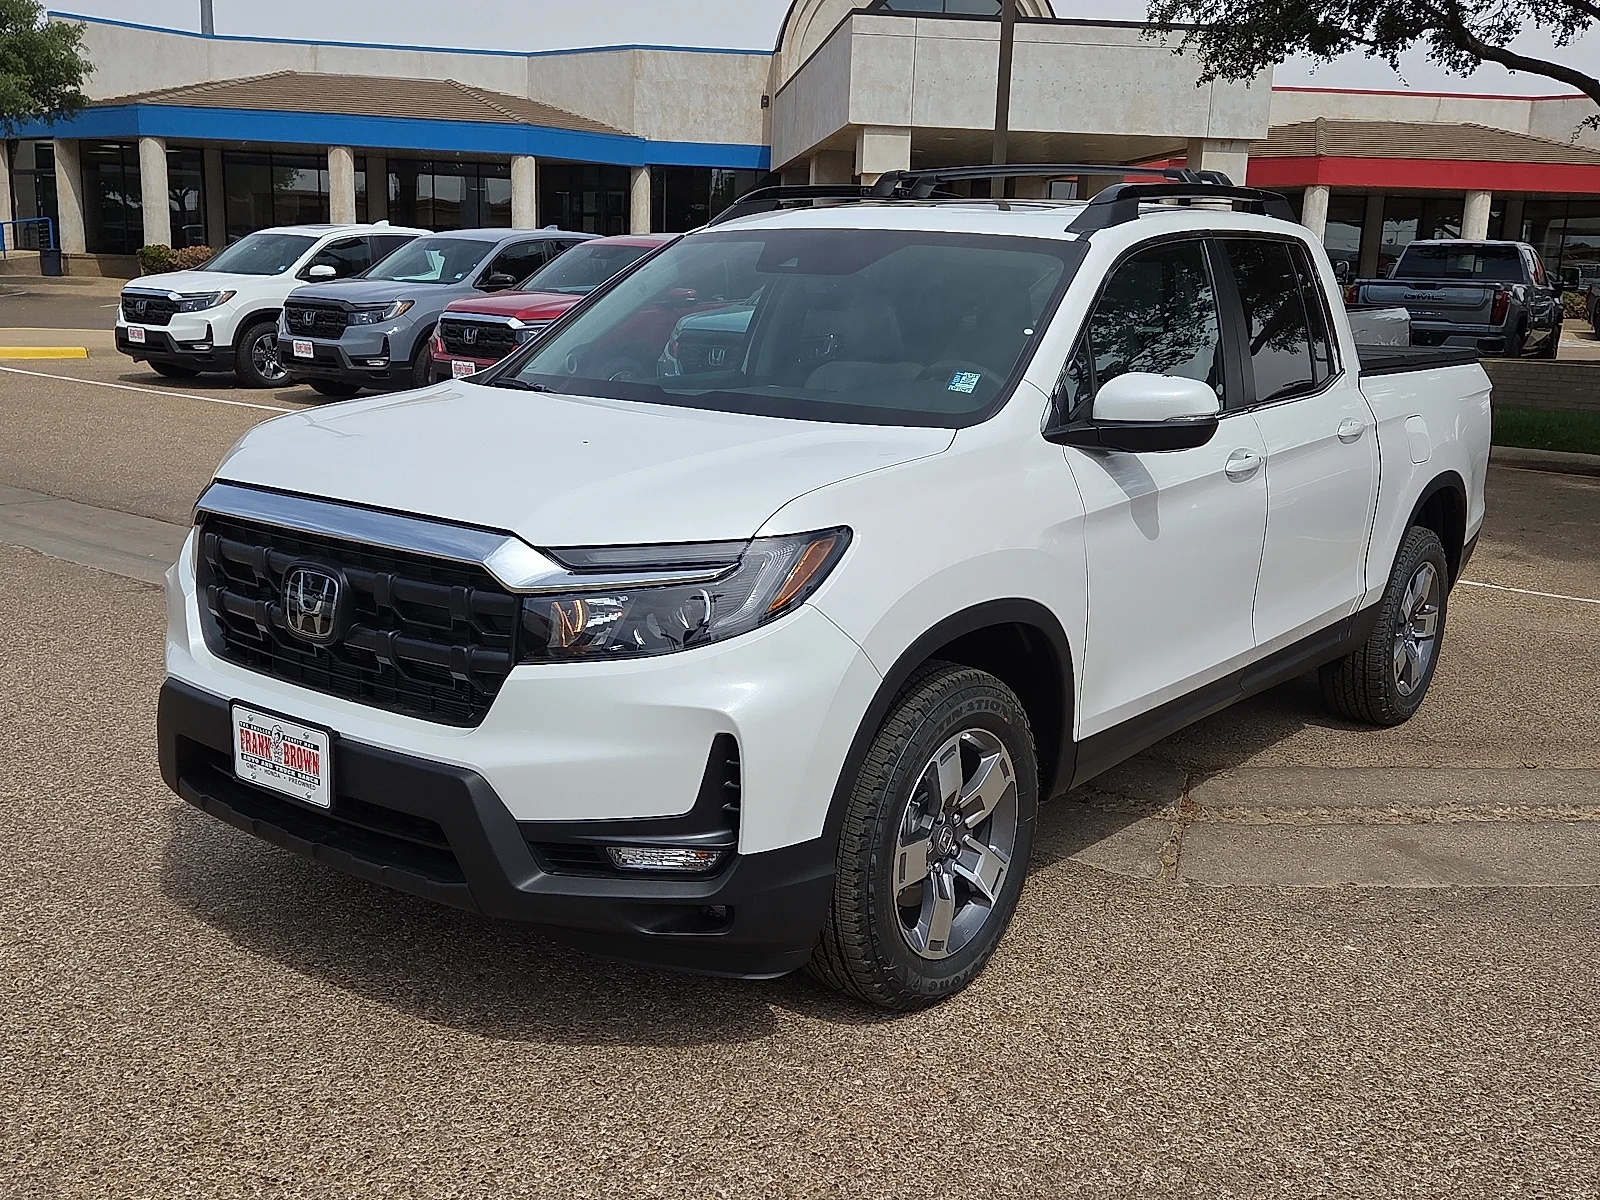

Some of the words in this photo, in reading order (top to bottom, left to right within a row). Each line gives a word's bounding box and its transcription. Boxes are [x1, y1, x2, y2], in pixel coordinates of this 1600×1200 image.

[1404, 292, 1446, 300] GMC
[239, 727, 271, 760] FRANK
[283, 742, 319, 776] BROWN
[242, 753, 259, 764] AUTO
[260, 759, 273, 769] AND
[274, 764, 295, 777] TRUCK
[297, 772, 318, 784] RANCH
[245, 762, 256, 770] GMC
[263, 768, 280, 778] HONDA
[288, 776, 316, 791] PREOWNED
